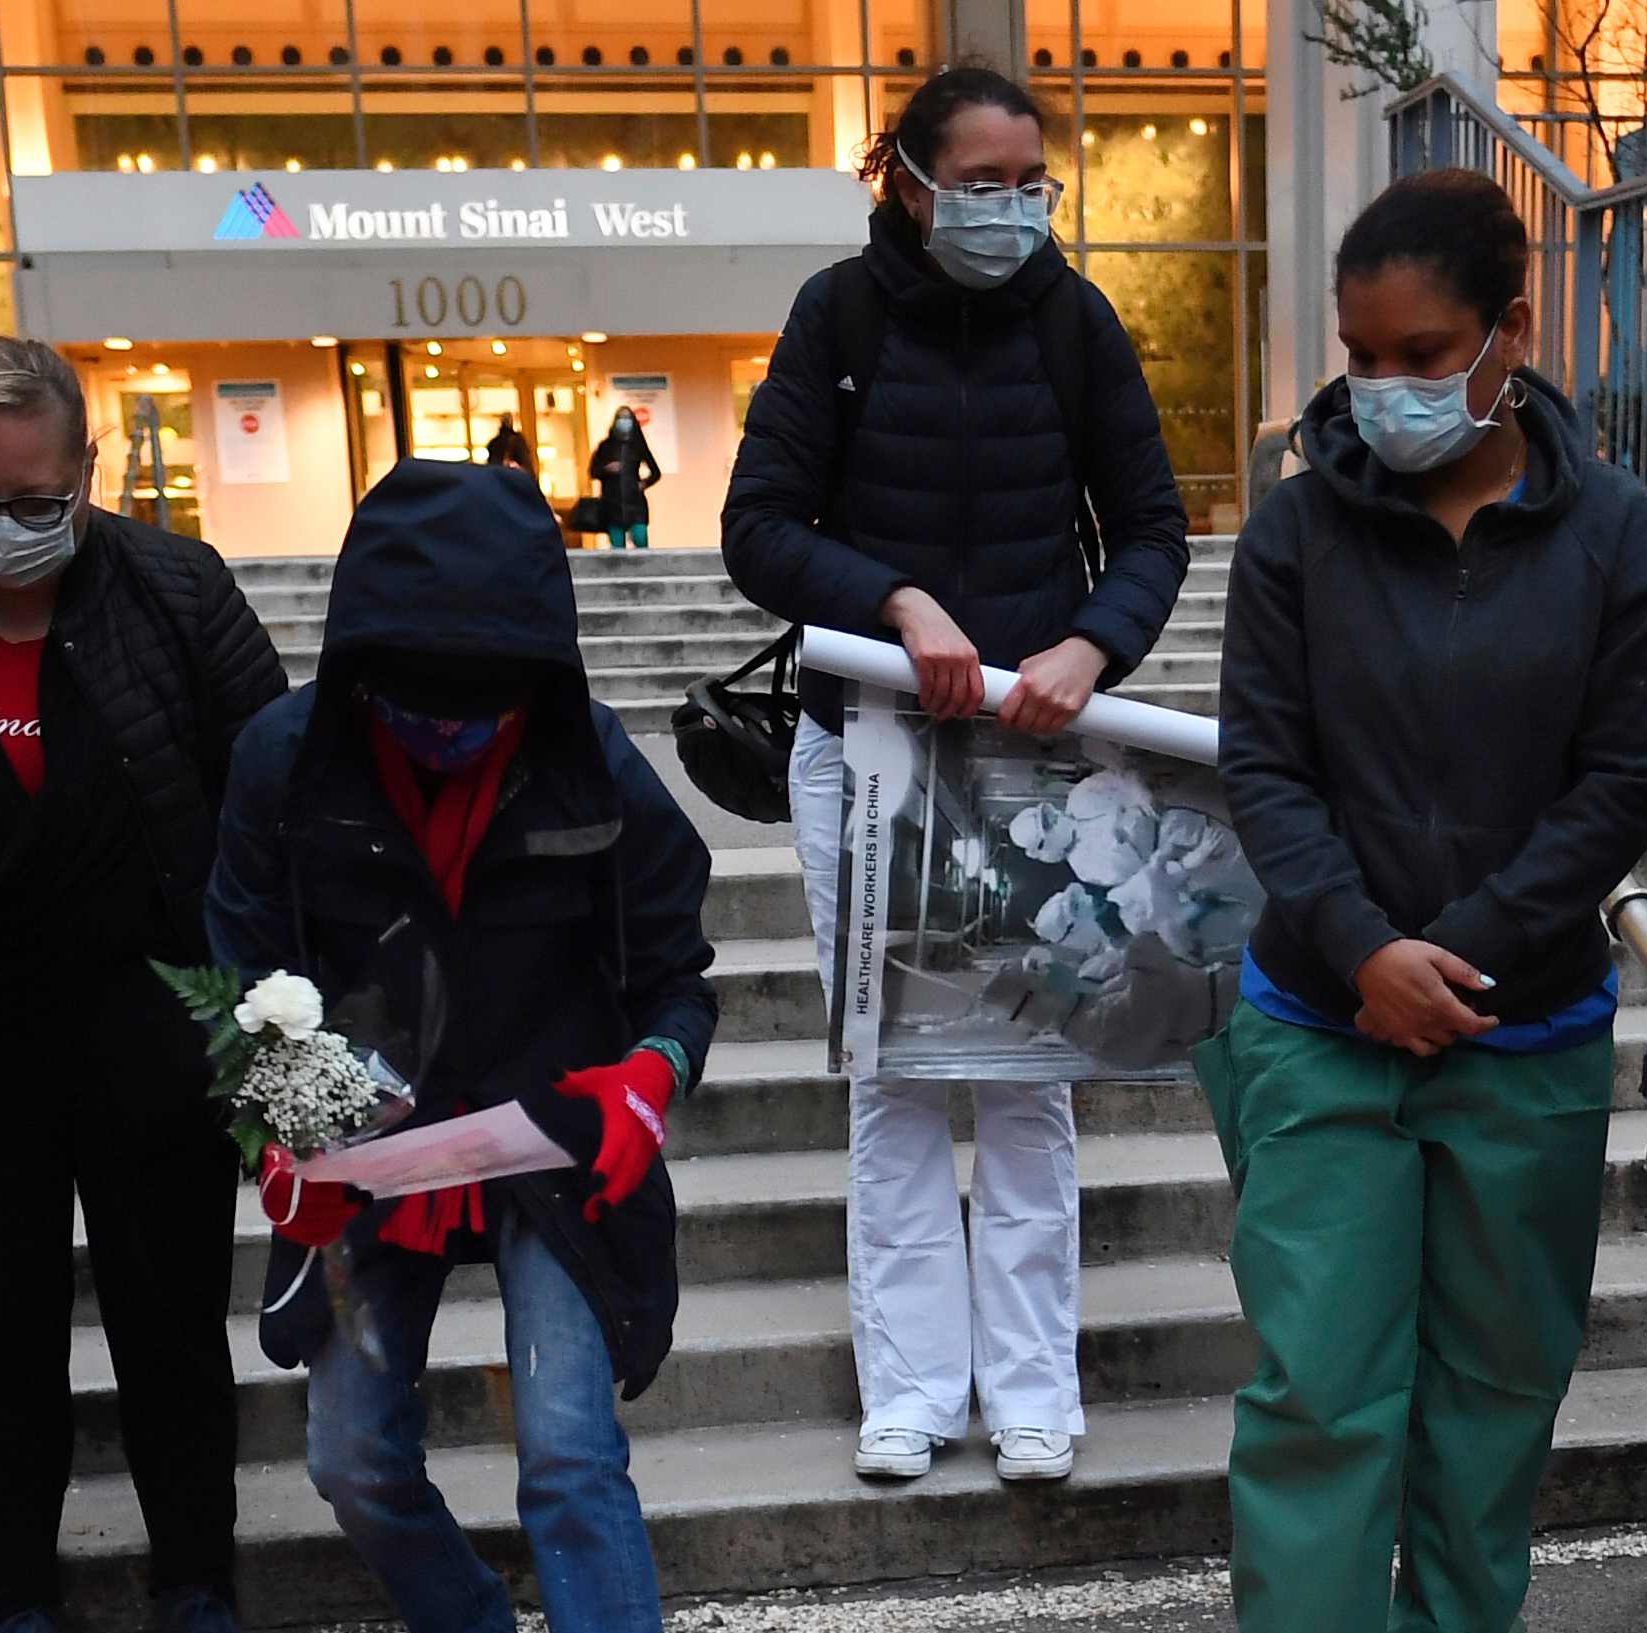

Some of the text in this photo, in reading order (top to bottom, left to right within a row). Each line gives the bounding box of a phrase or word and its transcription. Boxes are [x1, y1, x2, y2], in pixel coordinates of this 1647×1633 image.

[308, 198, 690, 241] Mount Sinai West
[388, 274, 528, 328] 1000
[856, 772, 881, 1015] HEALTHCARE WORKERS IN CHINA
